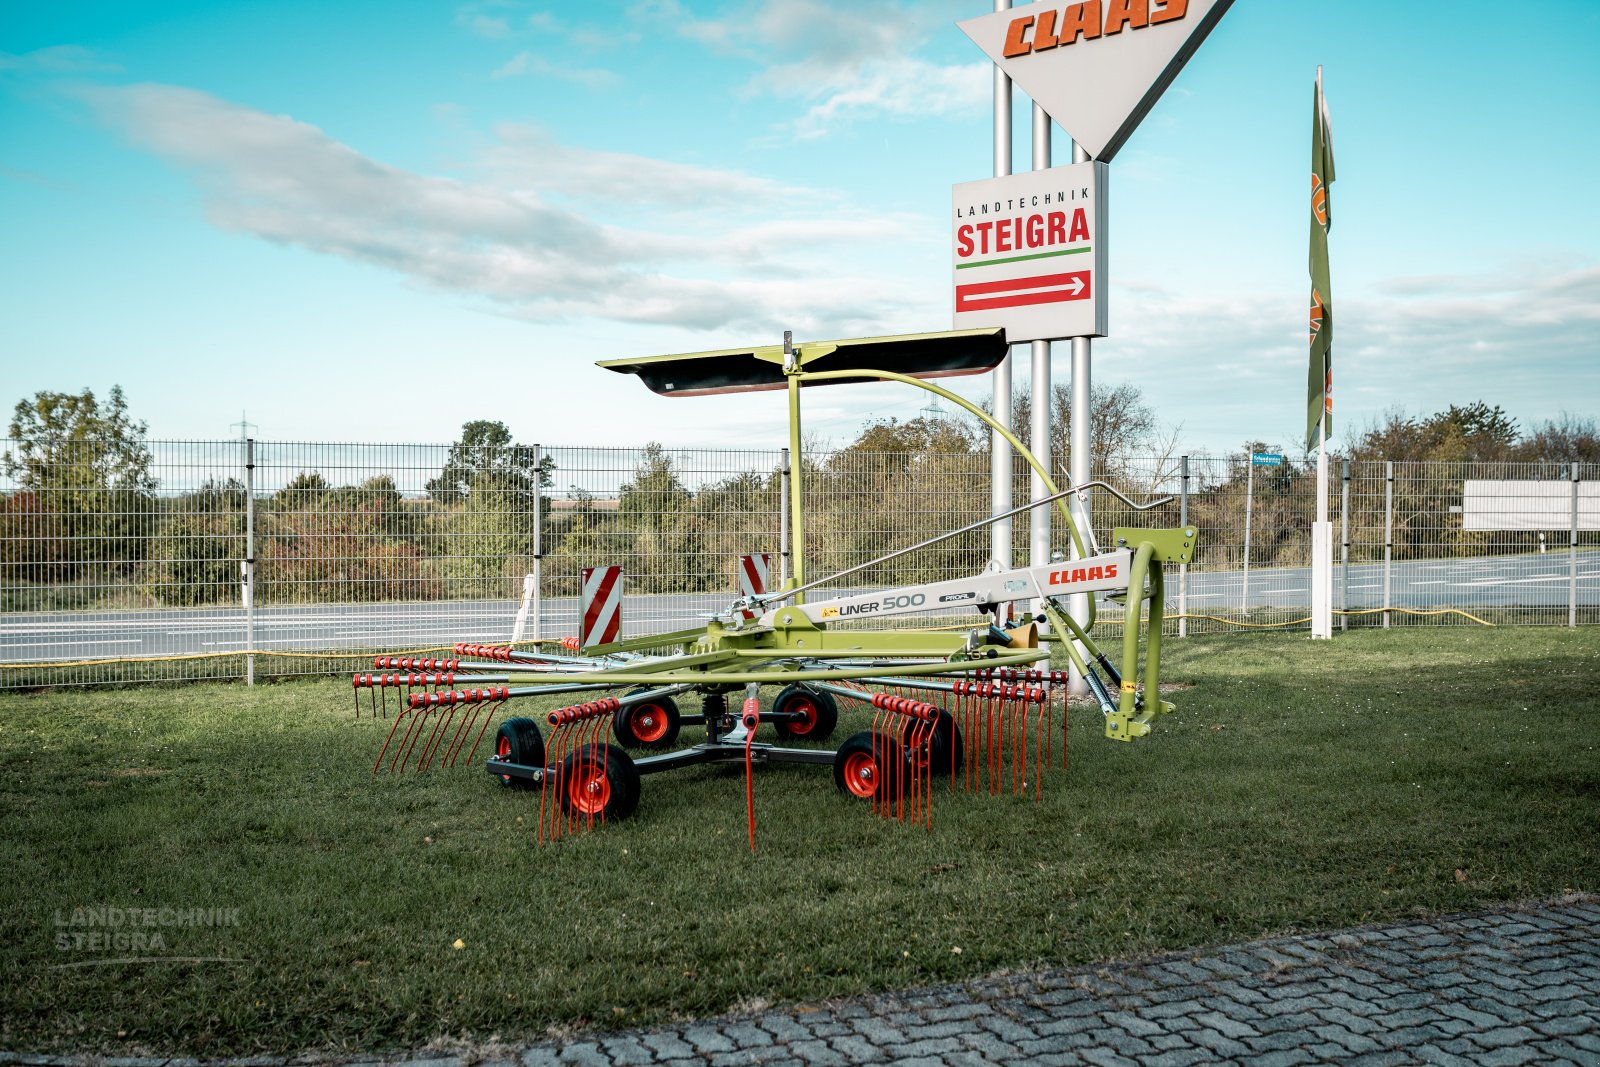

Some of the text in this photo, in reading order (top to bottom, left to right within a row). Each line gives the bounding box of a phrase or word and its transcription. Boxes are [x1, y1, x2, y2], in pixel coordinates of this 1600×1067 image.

[1003, 0, 1189, 58] CLAAS
[957, 188, 1089, 218] LANDTECHNIK
[957, 208, 1090, 257] STEIGRA
[1049, 564, 1117, 585] CLAAS
[839, 593, 926, 616] LINER 500
[945, 593, 970, 602] PROFIL
